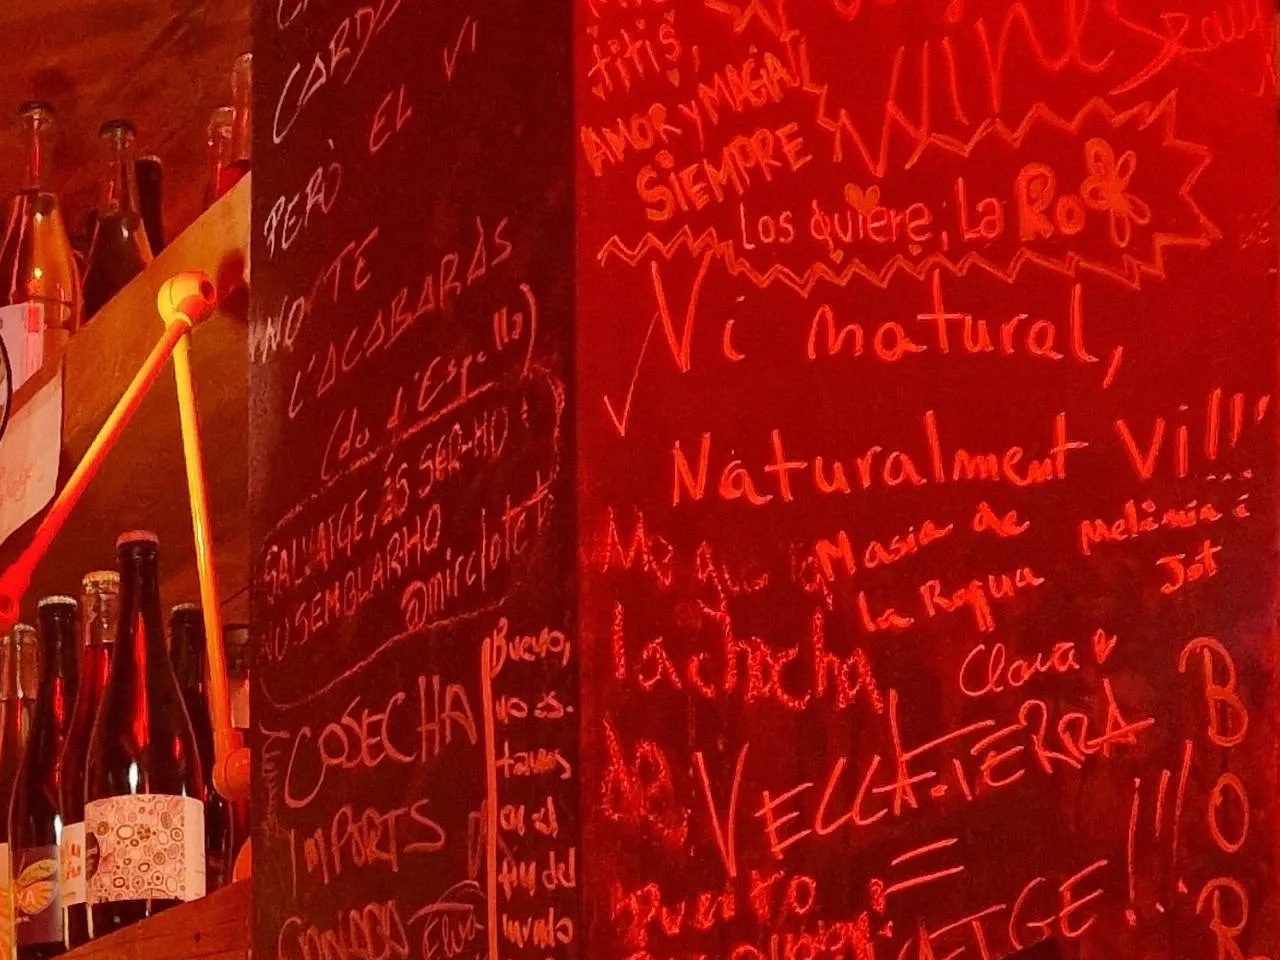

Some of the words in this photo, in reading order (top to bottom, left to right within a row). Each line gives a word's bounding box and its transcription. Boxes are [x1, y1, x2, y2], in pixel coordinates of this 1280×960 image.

[636, 121, 814, 222] SIEMPRE
[739, 201, 796, 251] Los
[283, 674, 478, 809] COSECHA
